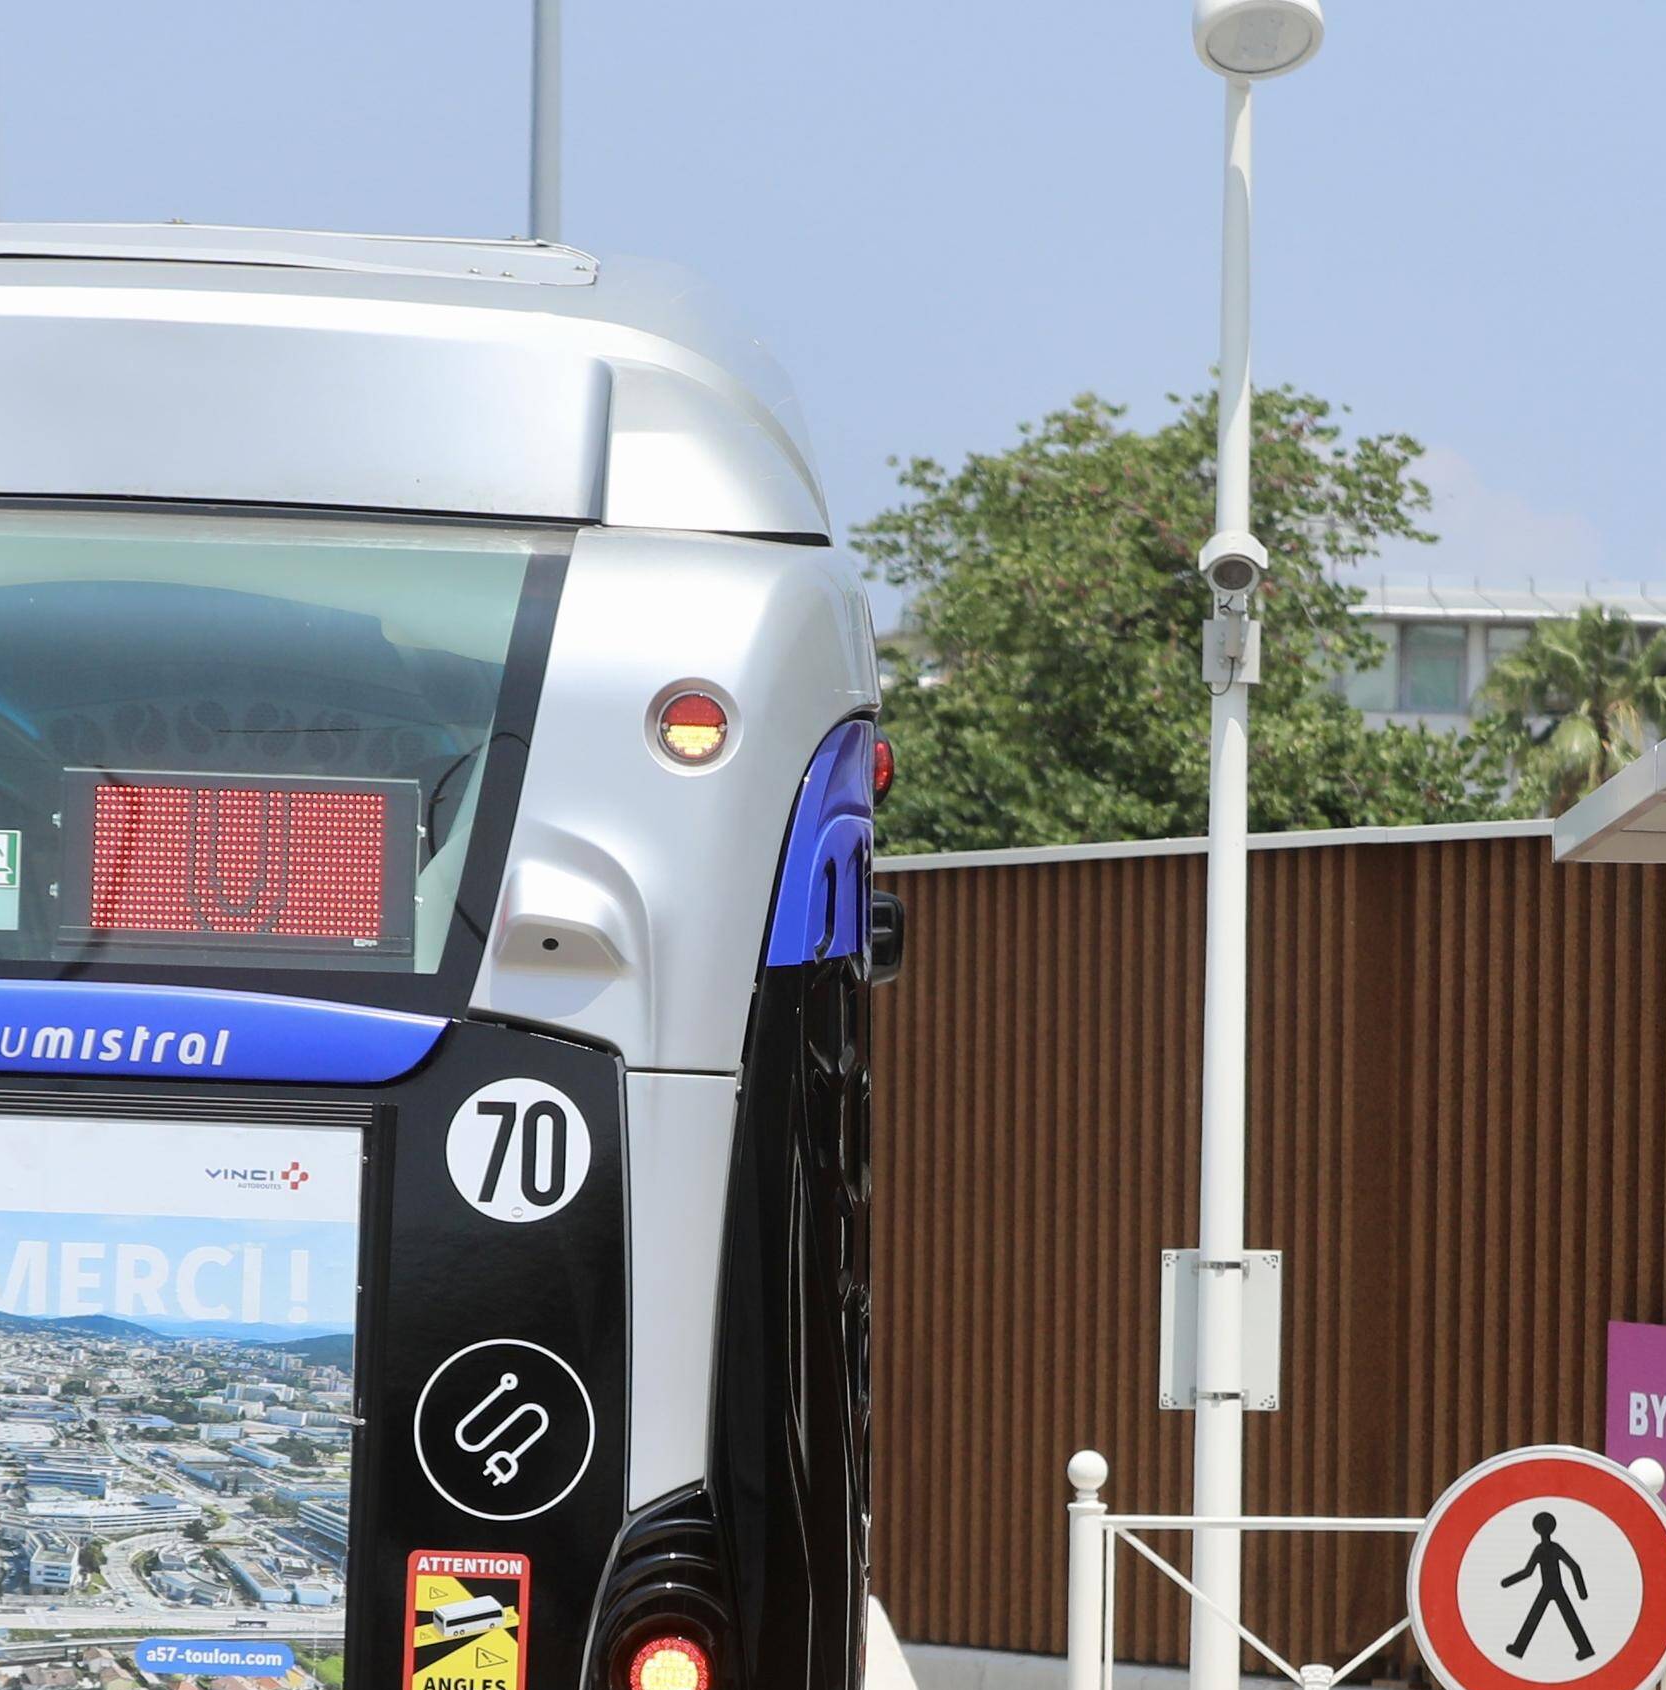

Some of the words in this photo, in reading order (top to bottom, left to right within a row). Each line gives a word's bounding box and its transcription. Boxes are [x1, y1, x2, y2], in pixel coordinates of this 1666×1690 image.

[477, 1100, 567, 1207] 70
[205, 1167, 275, 1182] VINCI
[417, 1556, 523, 1575] ATTENTION
[146, 1646, 282, 1667] a57-toulon.com
